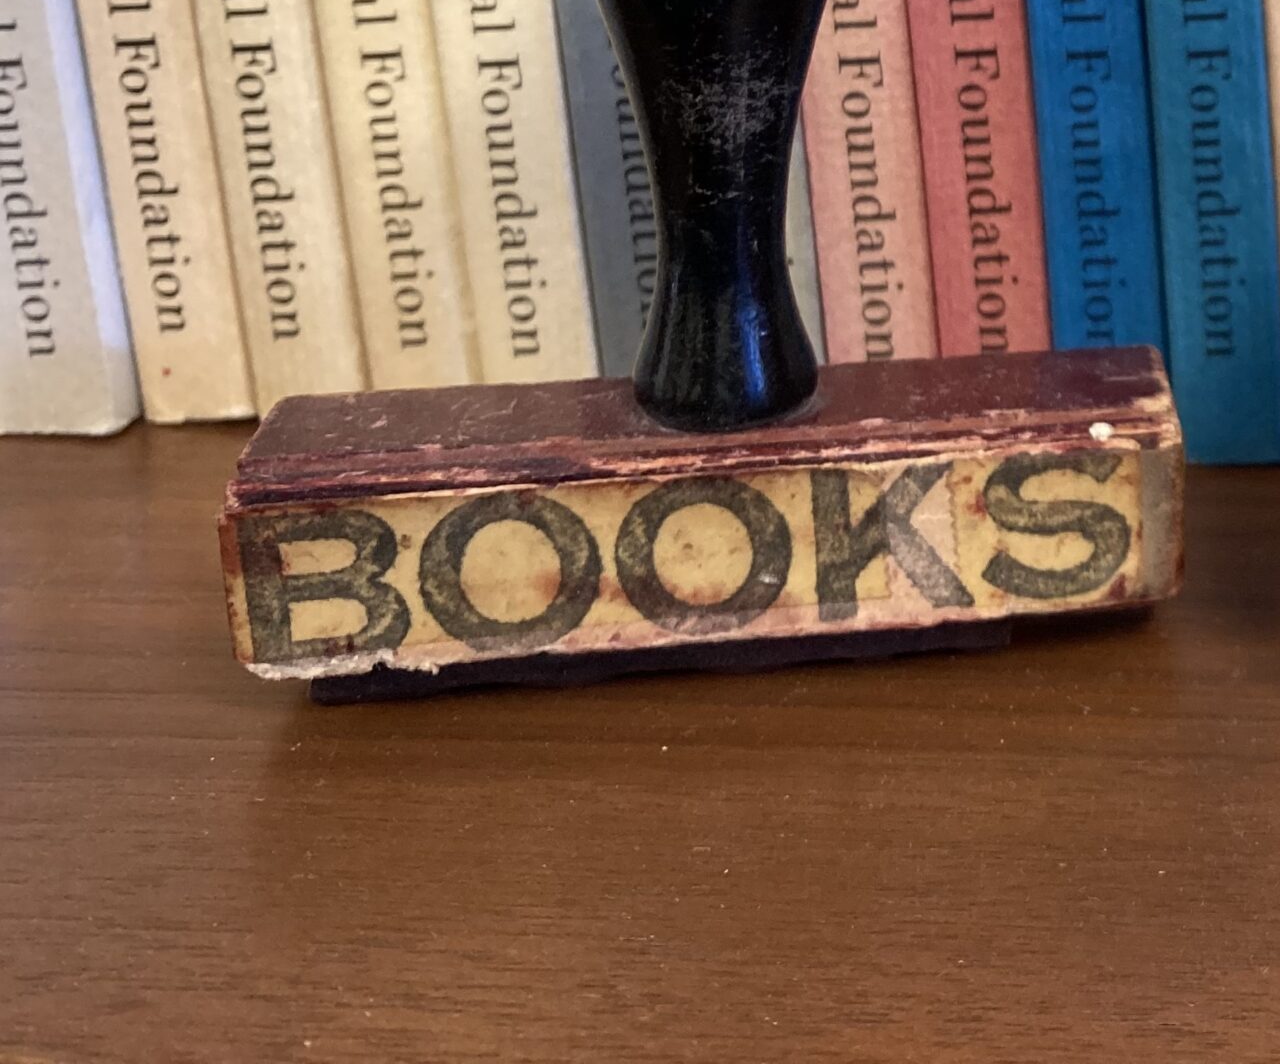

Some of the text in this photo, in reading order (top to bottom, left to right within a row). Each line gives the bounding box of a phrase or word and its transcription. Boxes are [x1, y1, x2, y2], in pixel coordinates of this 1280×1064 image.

[114, 35, 191, 333] Foundation
[230, 40, 305, 341] Foundation
[359, 47, 434, 350] Foundation
[477, 55, 547, 359] Foundation
[838, 50, 904, 361] Foundation
[954, 46, 1013, 354] Foundation
[1185, 44, 1242, 358] Foundation
[238, 451, 1133, 664] BOOKS
